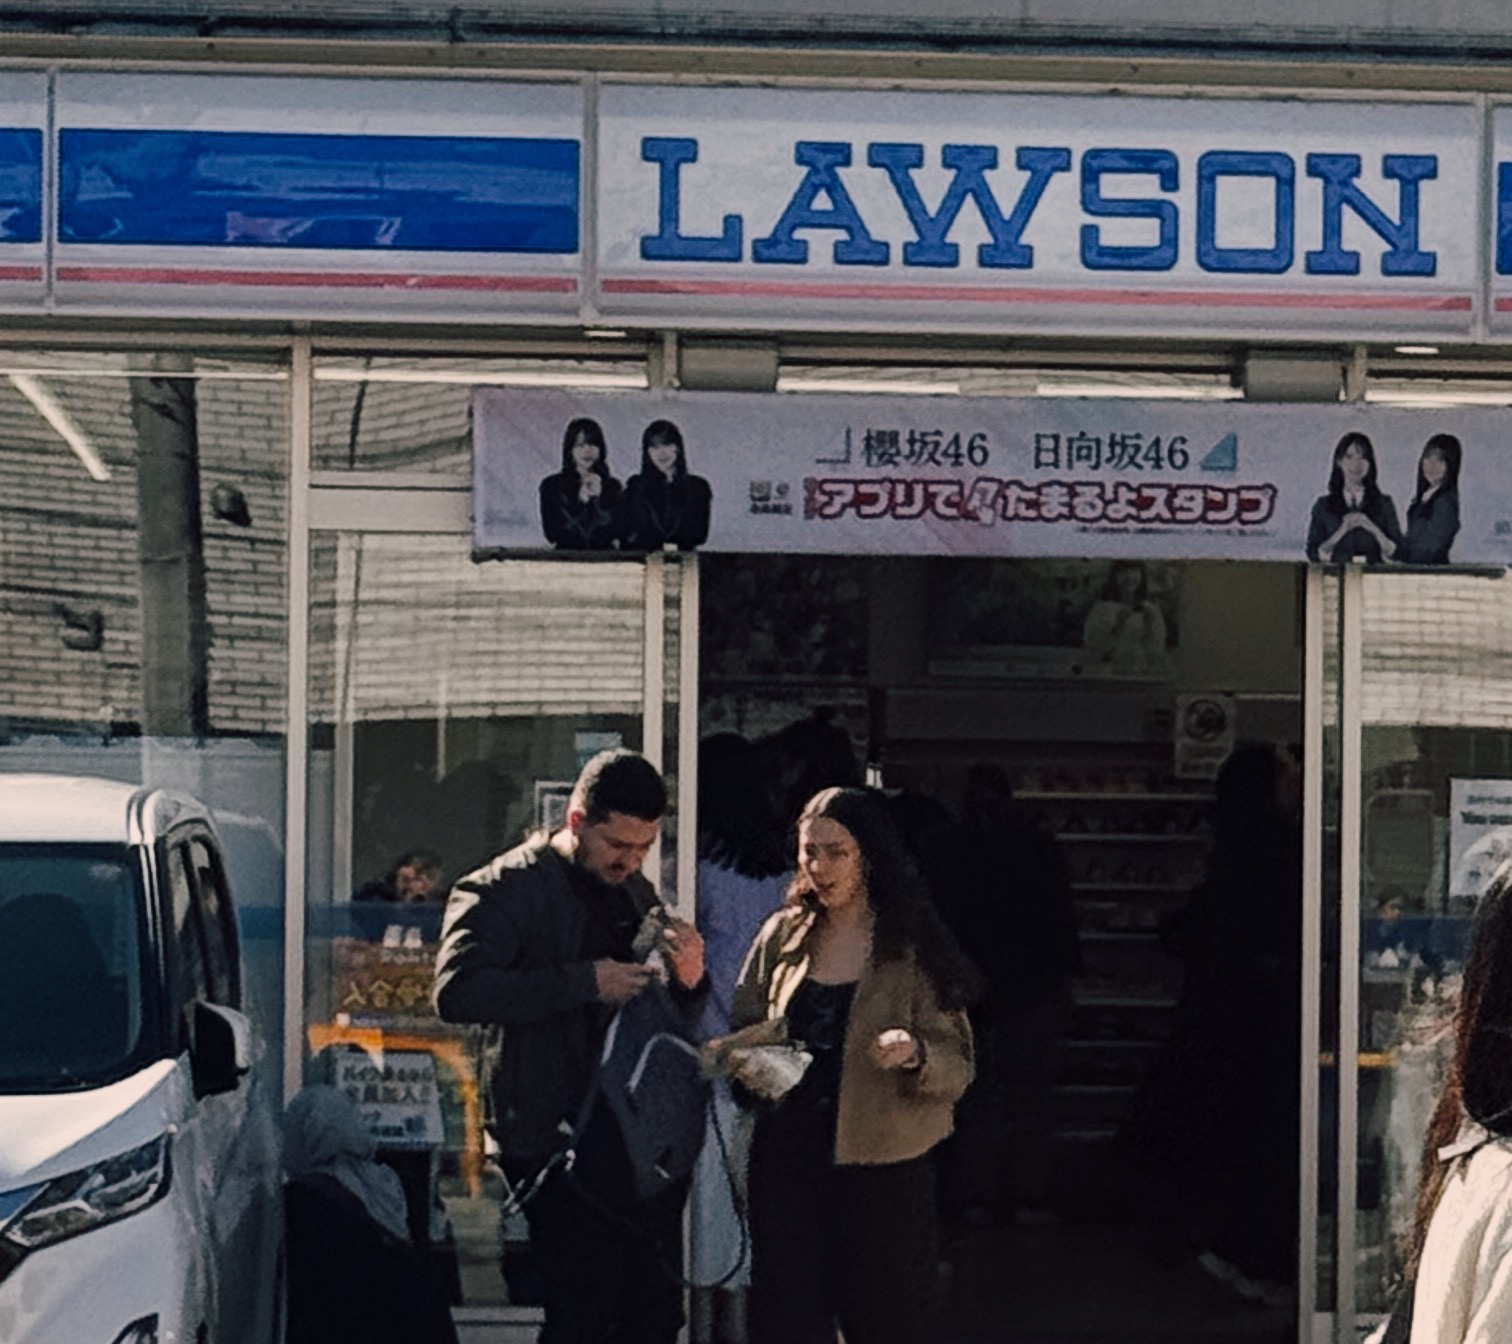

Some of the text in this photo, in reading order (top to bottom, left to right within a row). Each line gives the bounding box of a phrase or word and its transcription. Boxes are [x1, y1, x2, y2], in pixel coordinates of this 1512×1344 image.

[640, 137, 1439, 276] LAWSON
[863, 427, 1190, 471] 櫻坂46 日向坂46
